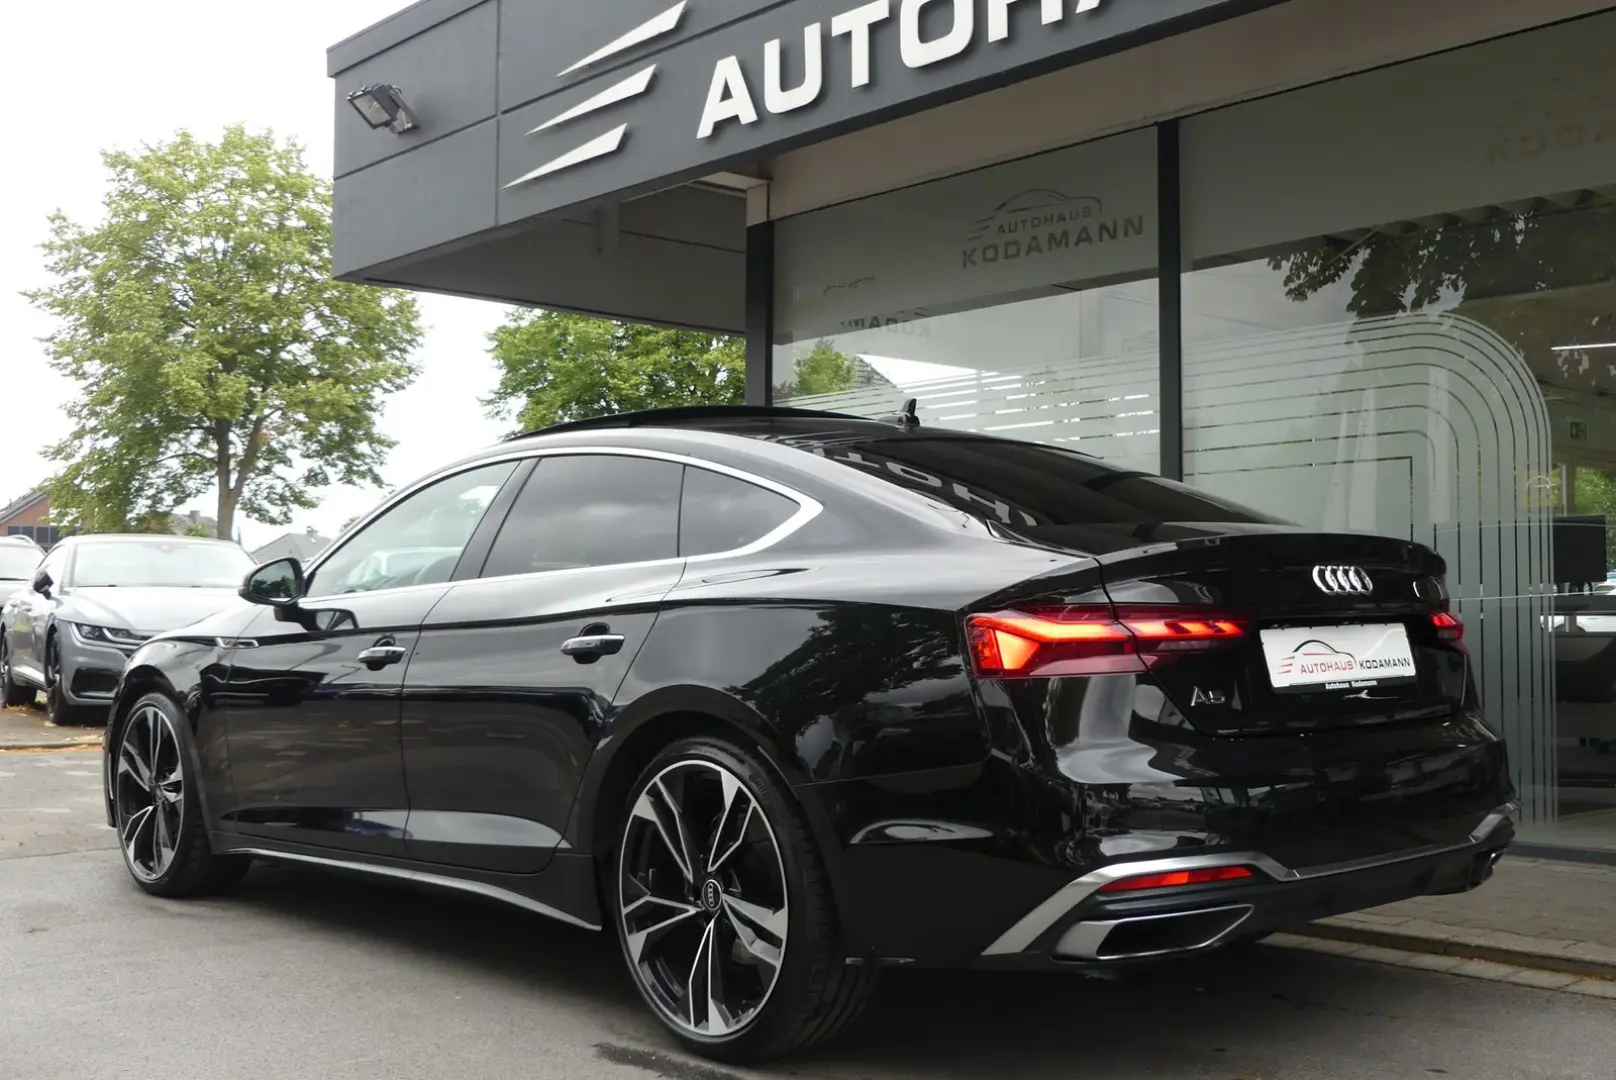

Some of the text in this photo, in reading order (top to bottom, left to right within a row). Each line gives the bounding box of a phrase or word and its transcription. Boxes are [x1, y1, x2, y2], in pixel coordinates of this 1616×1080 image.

[696, 0, 1101, 138] AUTO
[962, 214, 1144, 269] KODAMANN
[996, 206, 1092, 235] AUTOHAUS
[1300, 657, 1411, 675] AUTOHAUS KODAMANN
